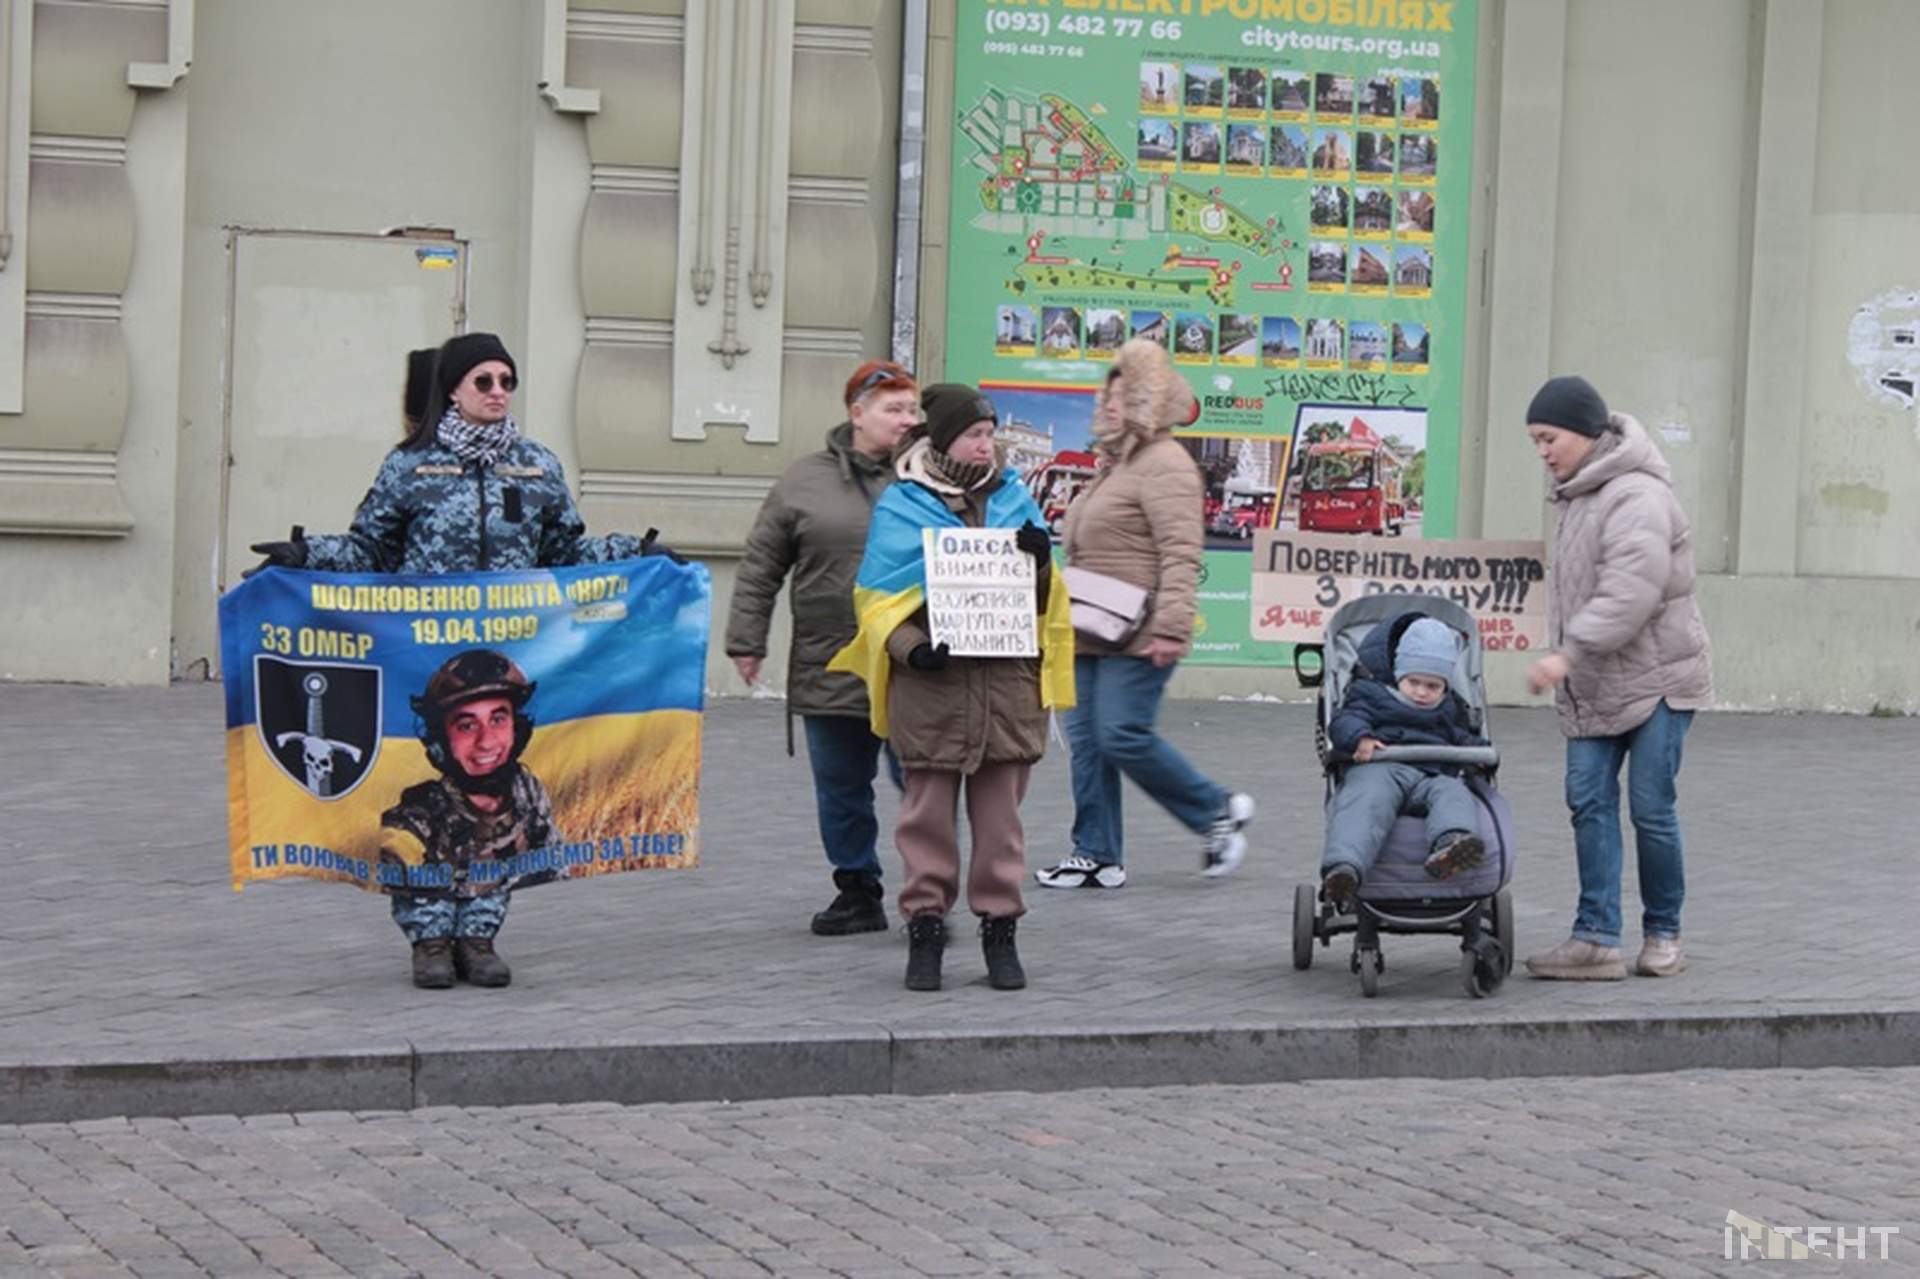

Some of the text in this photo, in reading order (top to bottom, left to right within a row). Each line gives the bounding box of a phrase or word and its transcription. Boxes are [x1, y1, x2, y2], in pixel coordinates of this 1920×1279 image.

[985, 9, 1182, 40] (093) 482 77 66
[1241, 25, 1440, 58] citytours.org.ua
[1203, 395, 1265, 410] REDBUS
[942, 536, 1015, 556] ОДЕСА
[1484, 557, 1545, 581] ТАТА
[310, 584, 481, 612] ШОЛКОВЕНКО
[487, 584, 563, 611] НІКІТА
[260, 623, 374, 660] 33 ОМБР
[411, 615, 540, 644] 19.04.1999
[251, 845, 279, 868] ТИ
[599, 836, 625, 861] ЗА
[629, 834, 685, 858] ТЕБЕ!
